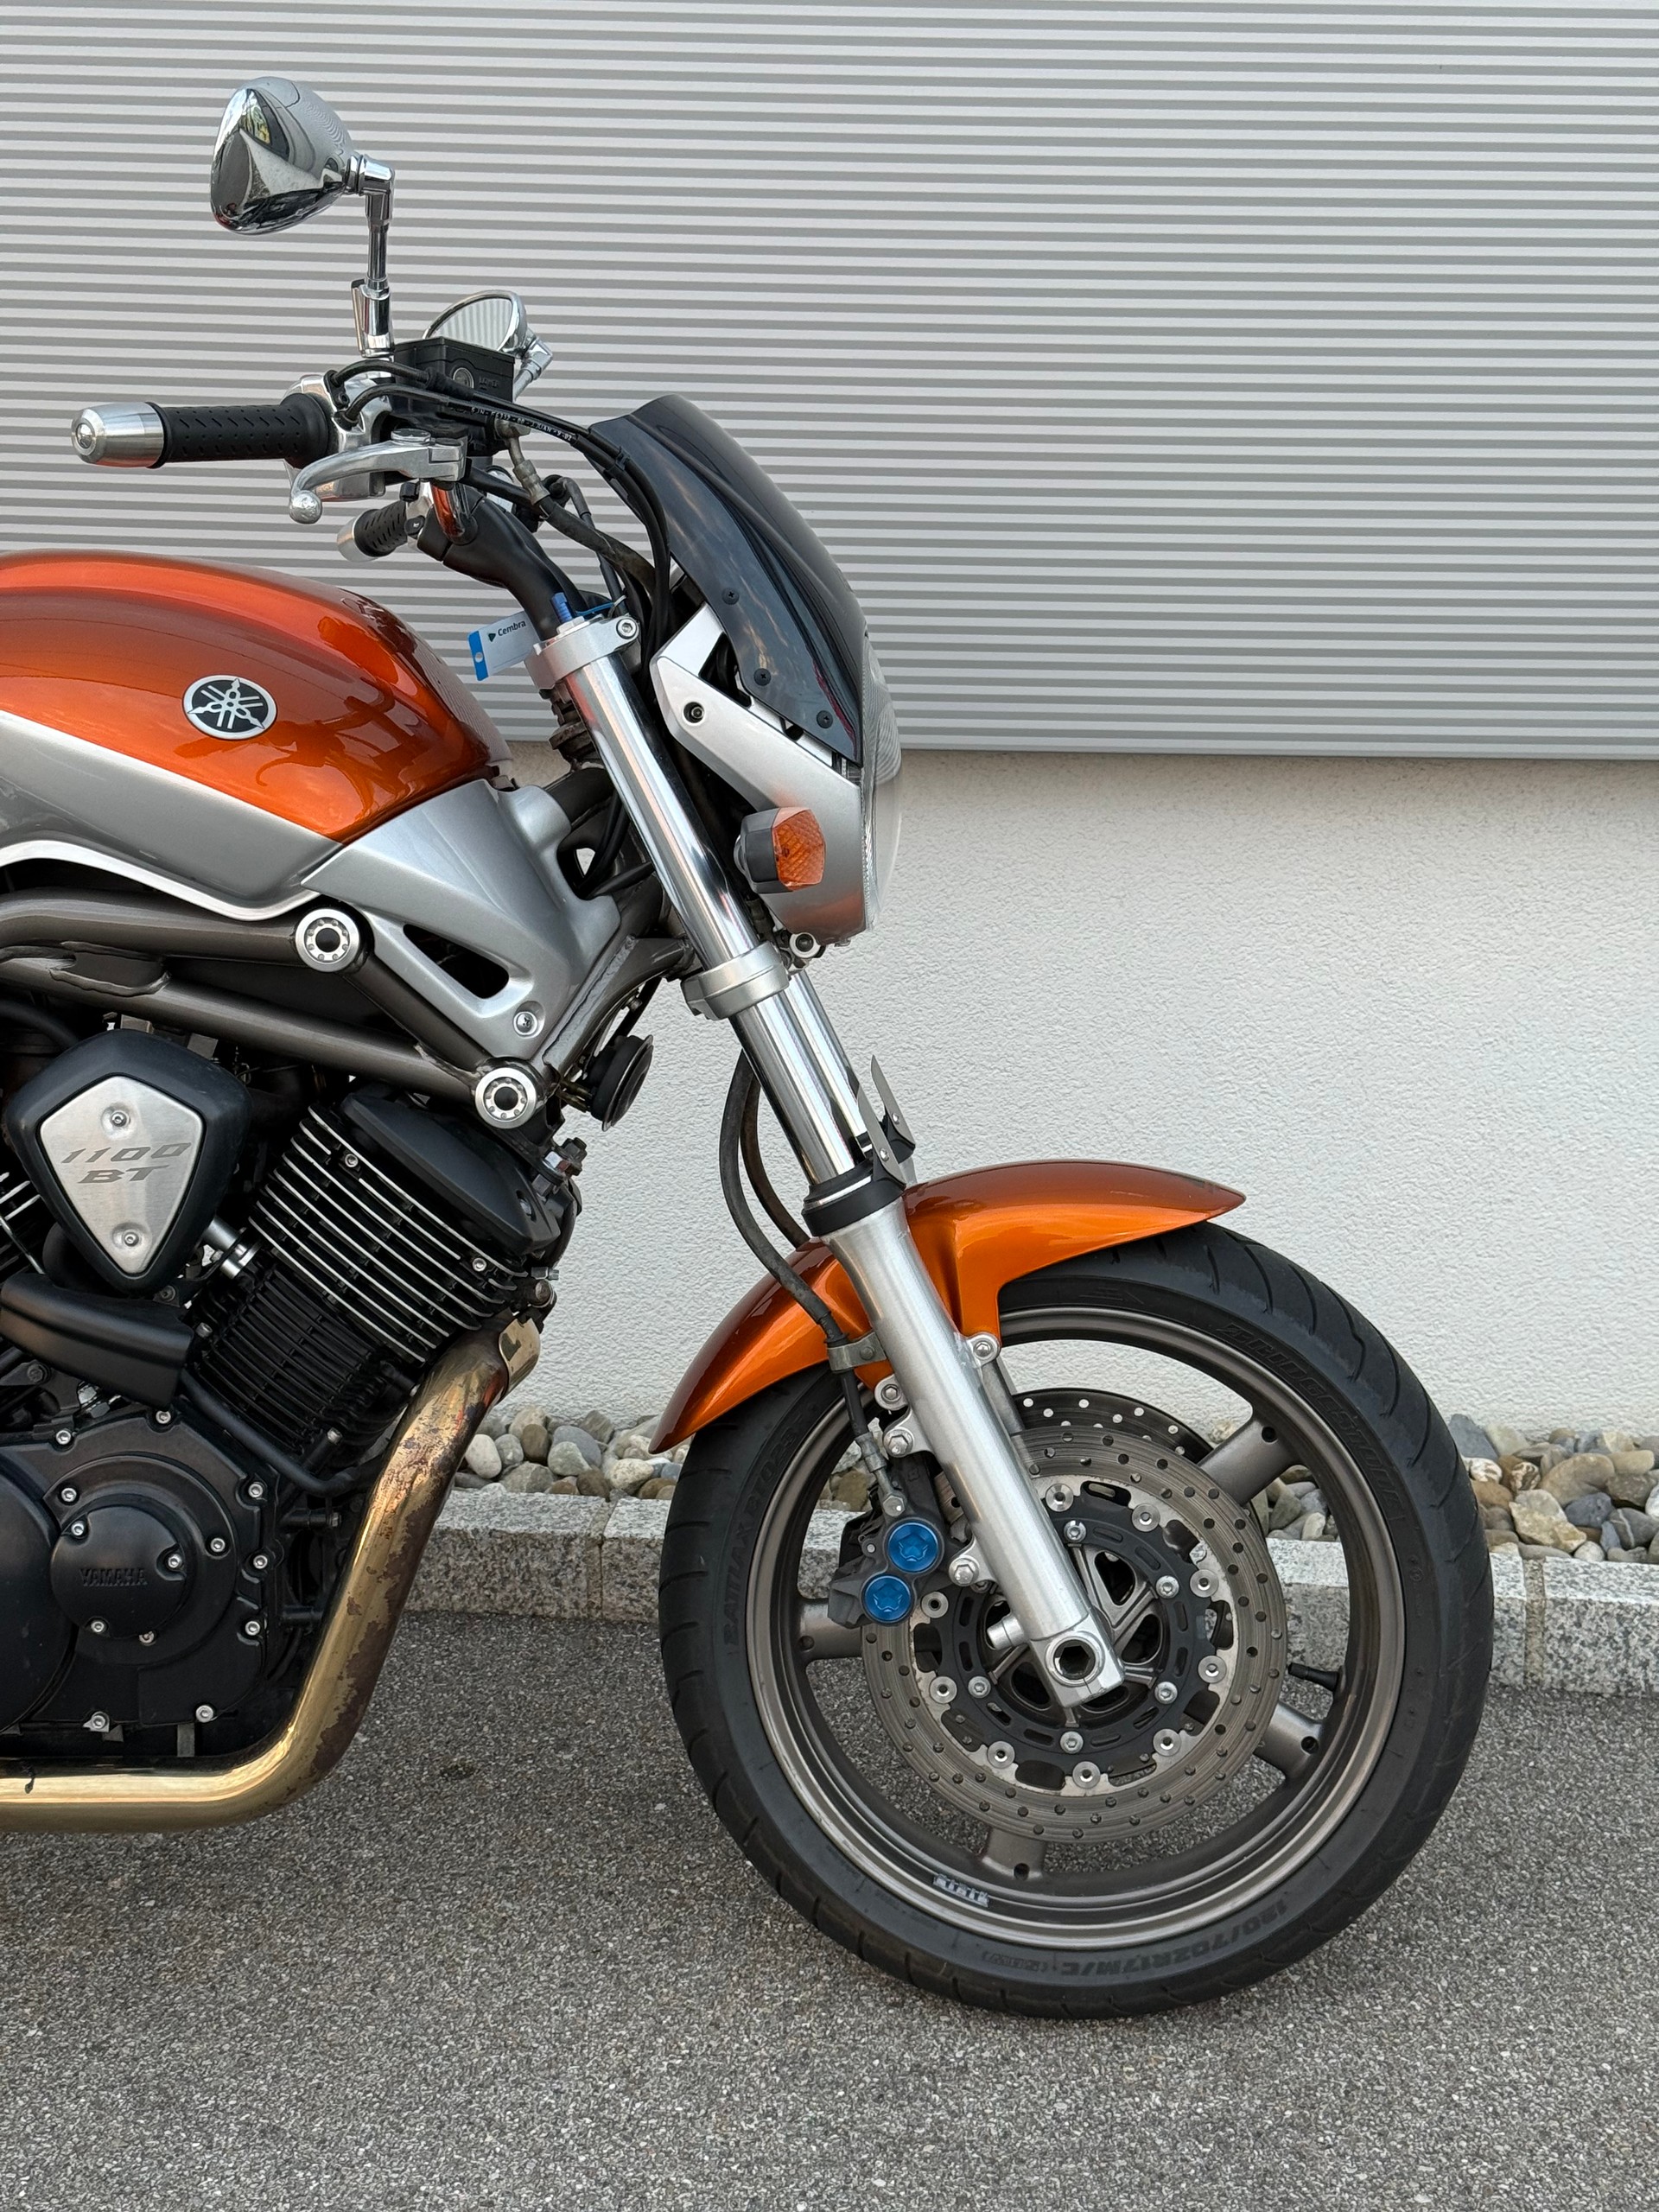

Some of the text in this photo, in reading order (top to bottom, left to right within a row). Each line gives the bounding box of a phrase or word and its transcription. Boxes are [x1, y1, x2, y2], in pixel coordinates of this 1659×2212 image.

[498, 620, 526, 636] Cembra
[61, 1142, 191, 1164] 1100
[77, 1164, 170, 1184] BT
[1217, 1322, 1404, 1511] BRIDGESTONE
[79, 1567, 149, 1587] YAMAHA
